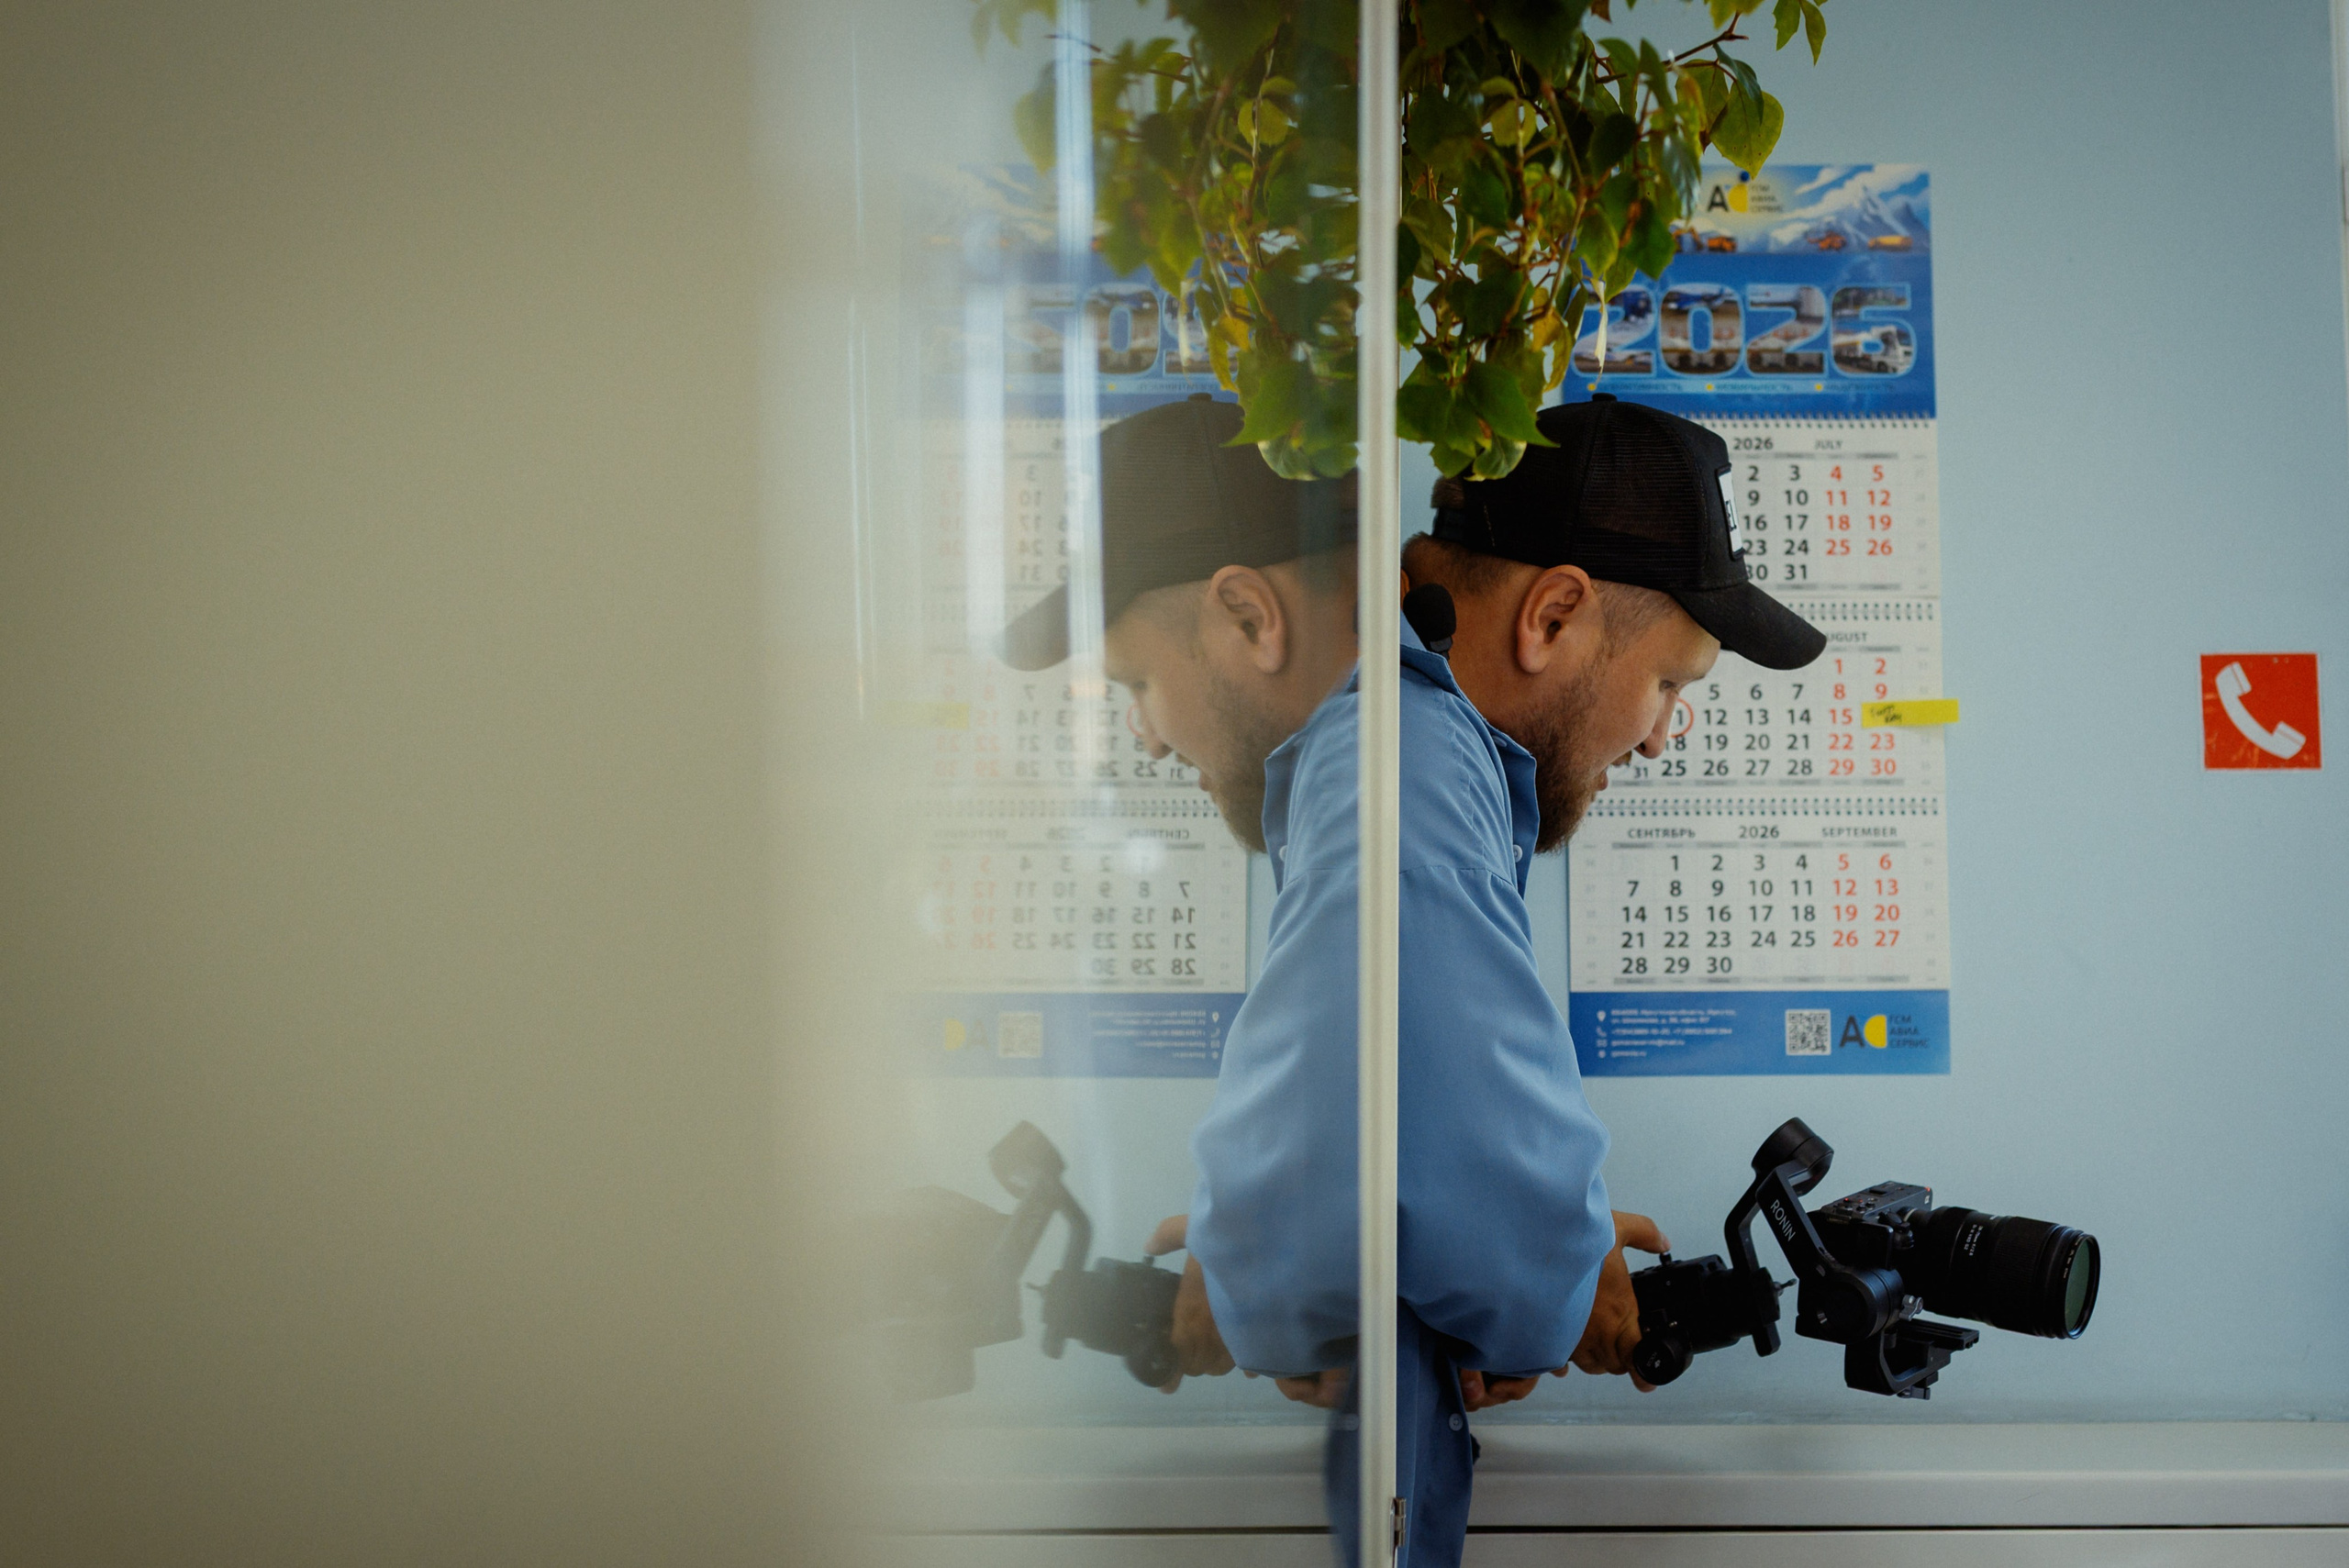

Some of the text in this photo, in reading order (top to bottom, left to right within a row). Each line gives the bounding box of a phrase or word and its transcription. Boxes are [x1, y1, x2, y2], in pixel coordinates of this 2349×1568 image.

[1573, 283, 1917, 378] 2026
[1734, 438, 1842, 450] 2026 JULY
[1749, 465, 1884, 481] 2 3 4 5
[1748, 490, 1890, 506] 9 10 11 12
[1744, 515, 1767, 530] 16
[1786, 515, 1808, 529] 17
[1828, 515, 1850, 530] 18
[1869, 515, 1891, 529] 19
[1744, 539, 1892, 555] 23 24 25 26
[1786, 564, 1807, 580] 31
[1827, 632, 1866, 643] UGUST
[1835, 659, 1886, 674] 1 2
[1709, 684, 1887, 700] 5 6 7 8 9
[1705, 709, 1726, 725] 12
[1746, 708, 1769, 725] 13
[1788, 709, 1810, 724] 14
[1830, 708, 1853, 724] 15
[1705, 734, 1728, 751] 19
[1745, 734, 1770, 750] 20
[1787, 734, 1809, 750] 21
[1830, 734, 1853, 750] 22
[1871, 734, 1894, 750] 23
[1635, 759, 1896, 778] 31 25 26 27 28 29 30
[1628, 828, 1695, 839] СЕНТЯБРЬ
[1741, 826, 1896, 839] 2026 SEPTEMBER
[1672, 853, 1891, 871] 1 2 3 4 5 6
[1628, 879, 1898, 896] 7 8 9 10 11 12 13
[1623, 905, 1899, 922] 14 15 16 17 18 19 20
[1622, 930, 1899, 948] 21 22 23 24 25 26 27
[1622, 957, 1731, 973] 28 29 30
[1770, 1199, 1796, 1241] RONIN
